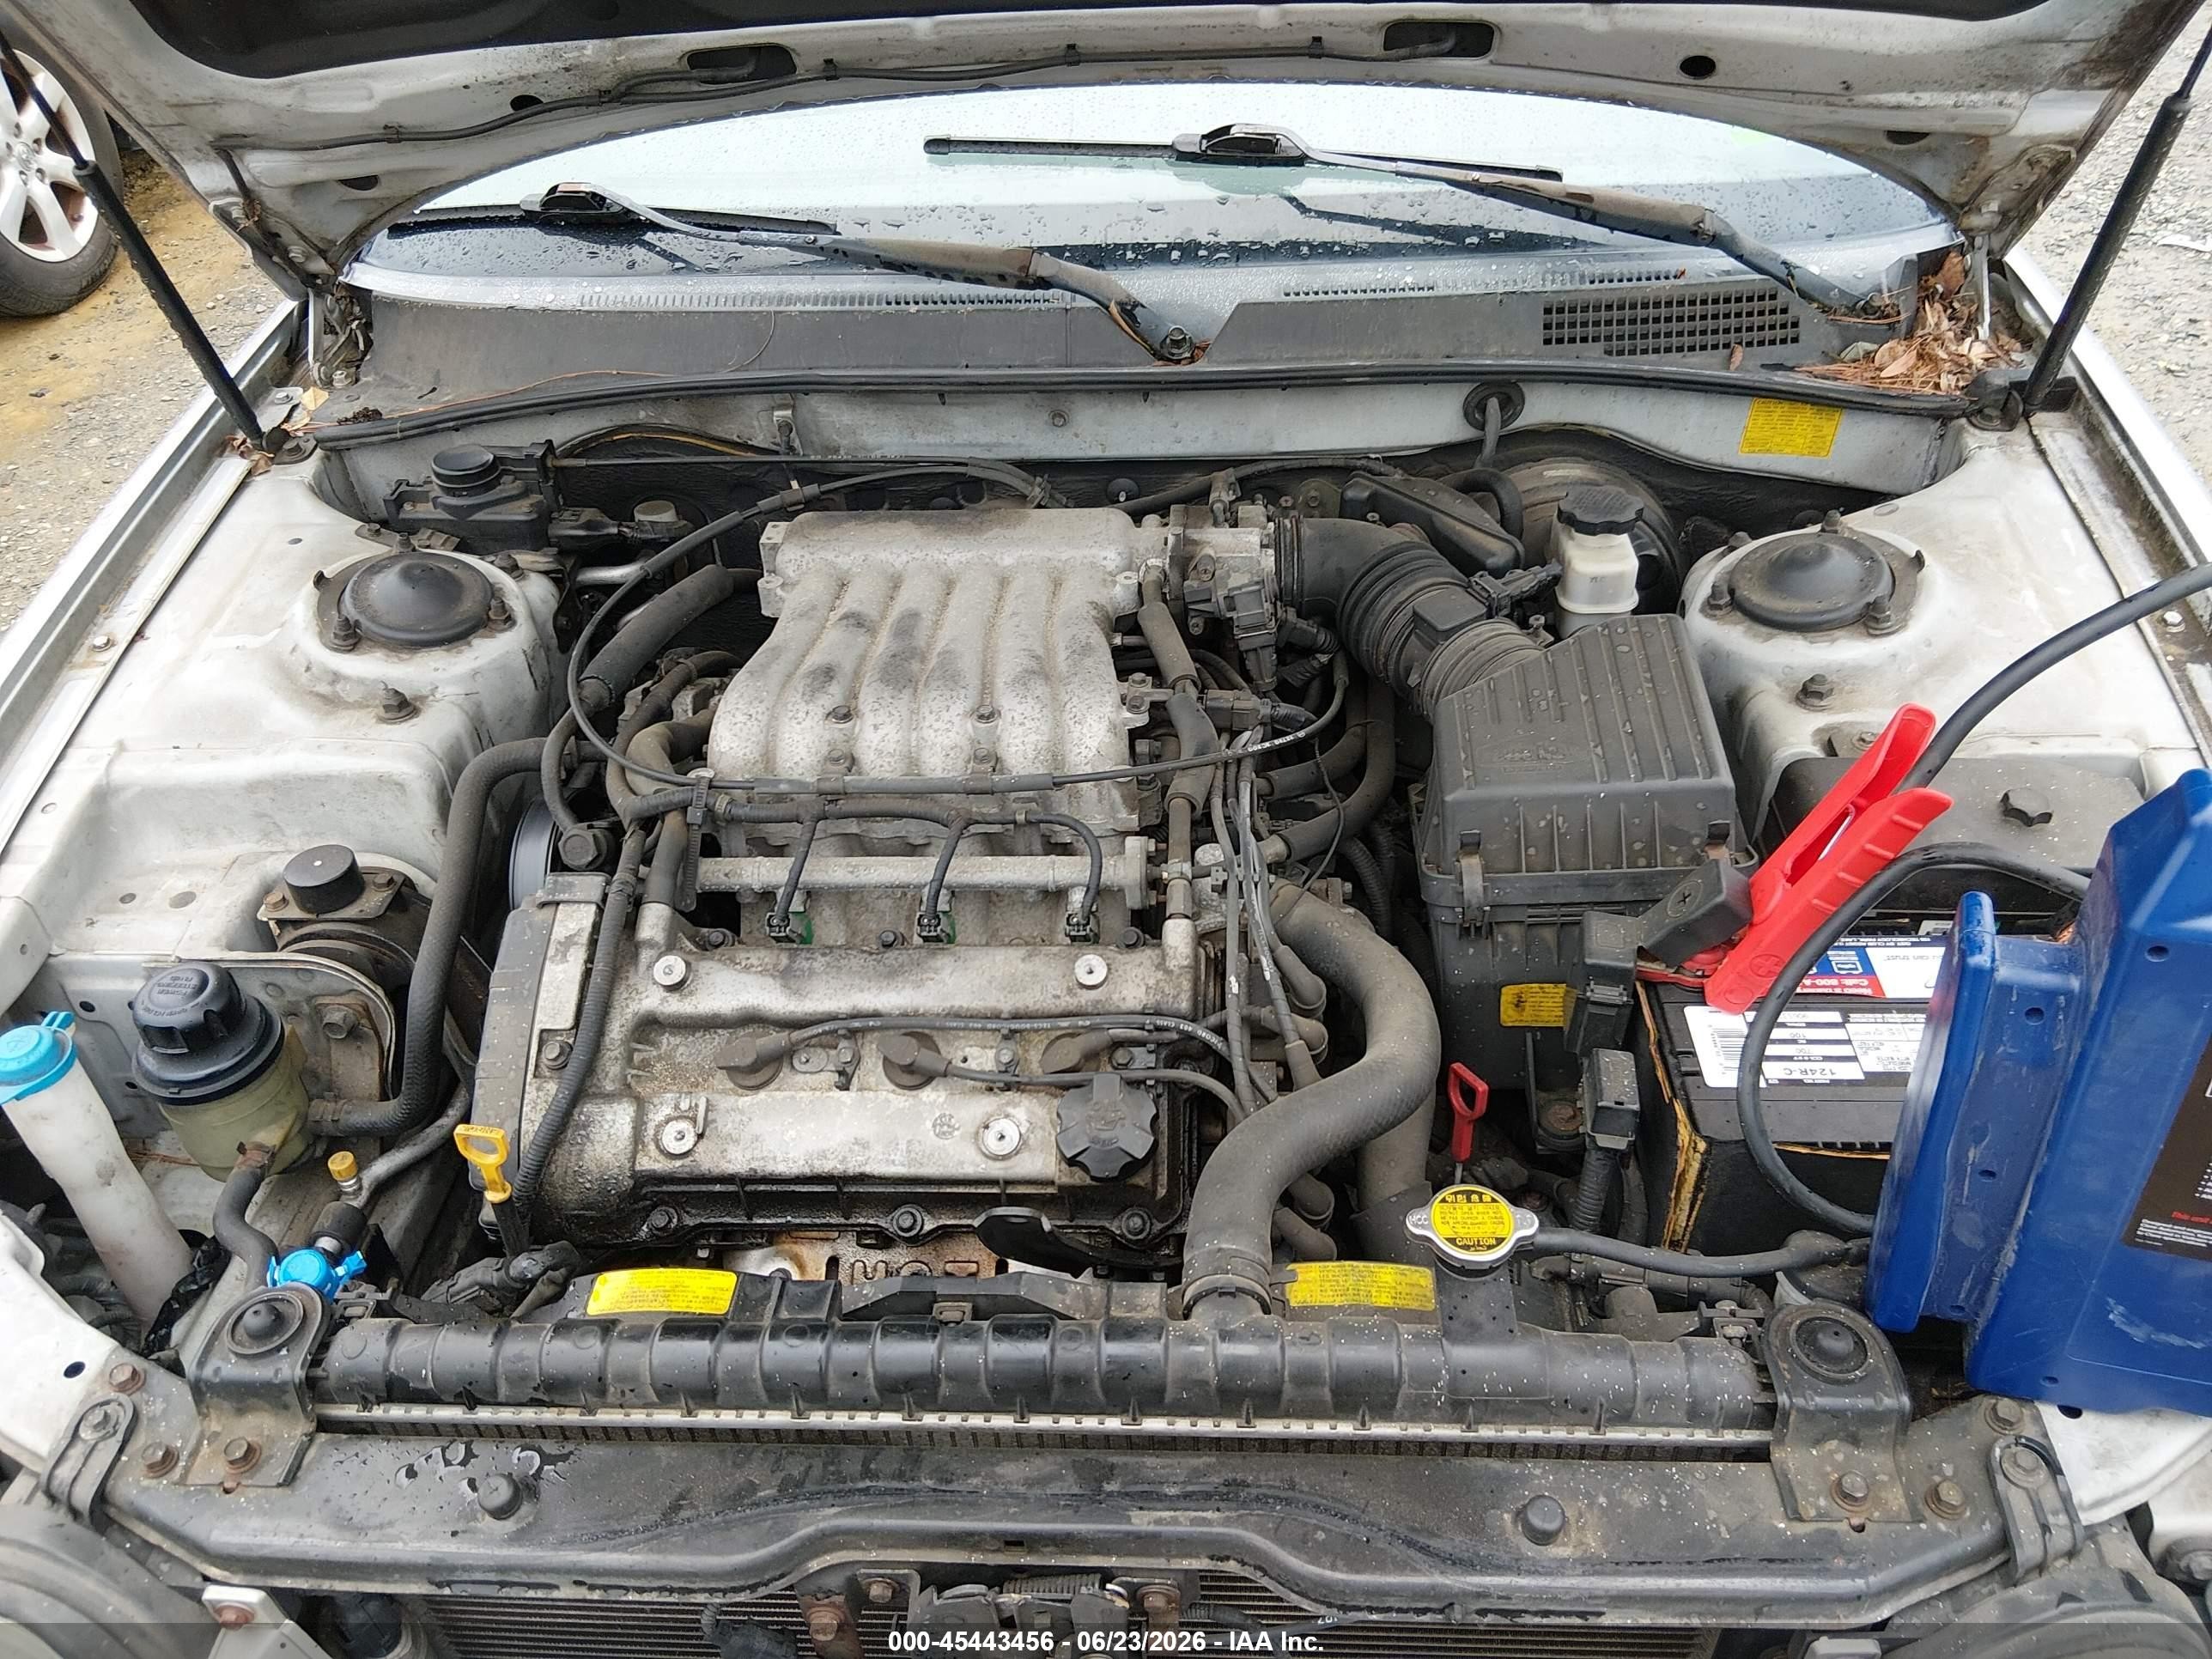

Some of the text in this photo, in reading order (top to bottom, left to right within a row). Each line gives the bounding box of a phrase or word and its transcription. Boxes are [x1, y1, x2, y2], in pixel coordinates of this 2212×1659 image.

[1783, 1067, 1837, 1076] 124R-C
[1408, 1214, 1429, 1224] HCC
[1455, 1237, 1496, 1246] CAUTION
